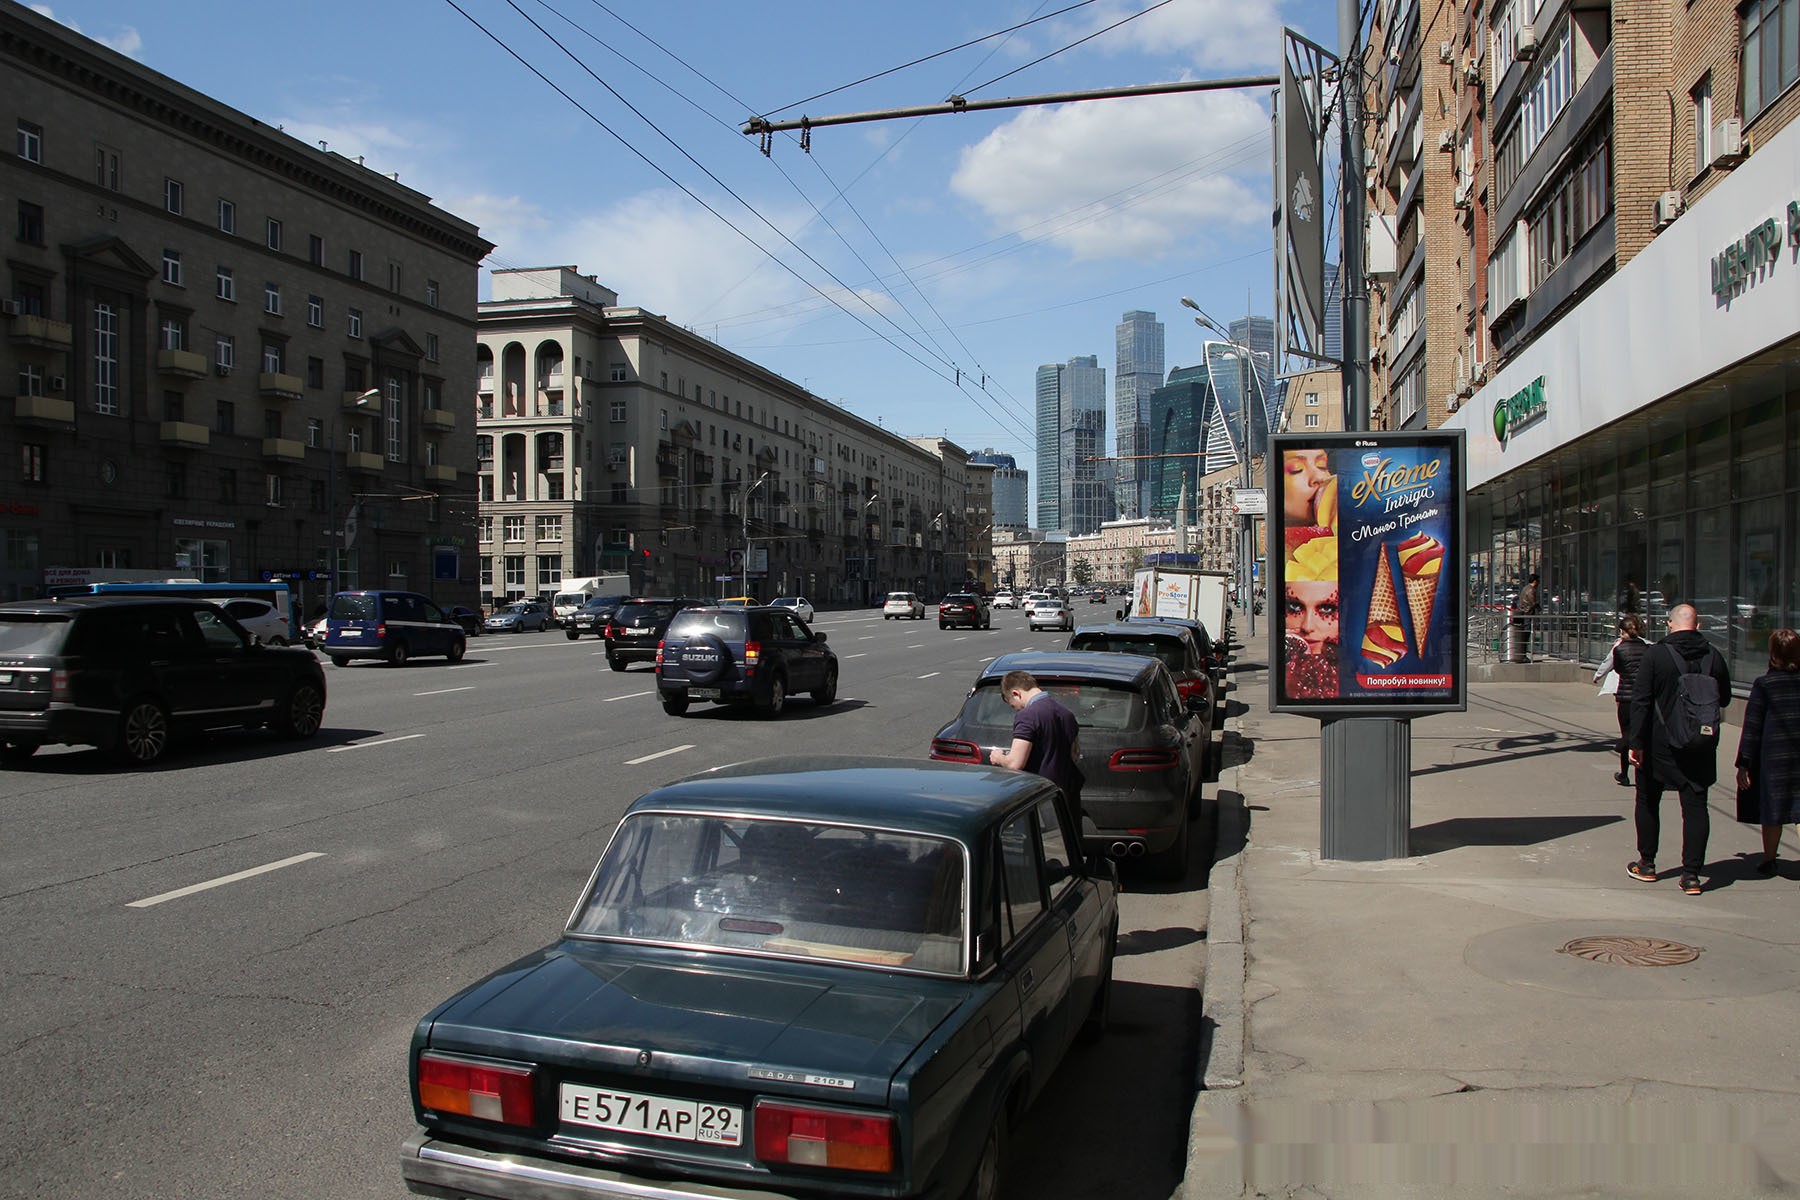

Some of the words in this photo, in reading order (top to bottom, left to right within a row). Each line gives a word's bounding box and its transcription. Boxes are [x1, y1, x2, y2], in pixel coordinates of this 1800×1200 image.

[1711, 217, 1782, 295] ЦЕНТР
[1384, 487, 1435, 513] Intriga
[1352, 521, 1397, 541] Манго
[1158, 591, 1188, 599] ProStore
[681, 653, 719, 662] SUZUKI
[1367, 676, 1407, 687] Попробуй
[1408, 676, 1446, 686] новинку!
[758, 1071, 794, 1080] LADA
[813, 1077, 845, 1086] 2105
[701, 1105, 732, 1131] 29
[699, 1128, 720, 1140] RUS
